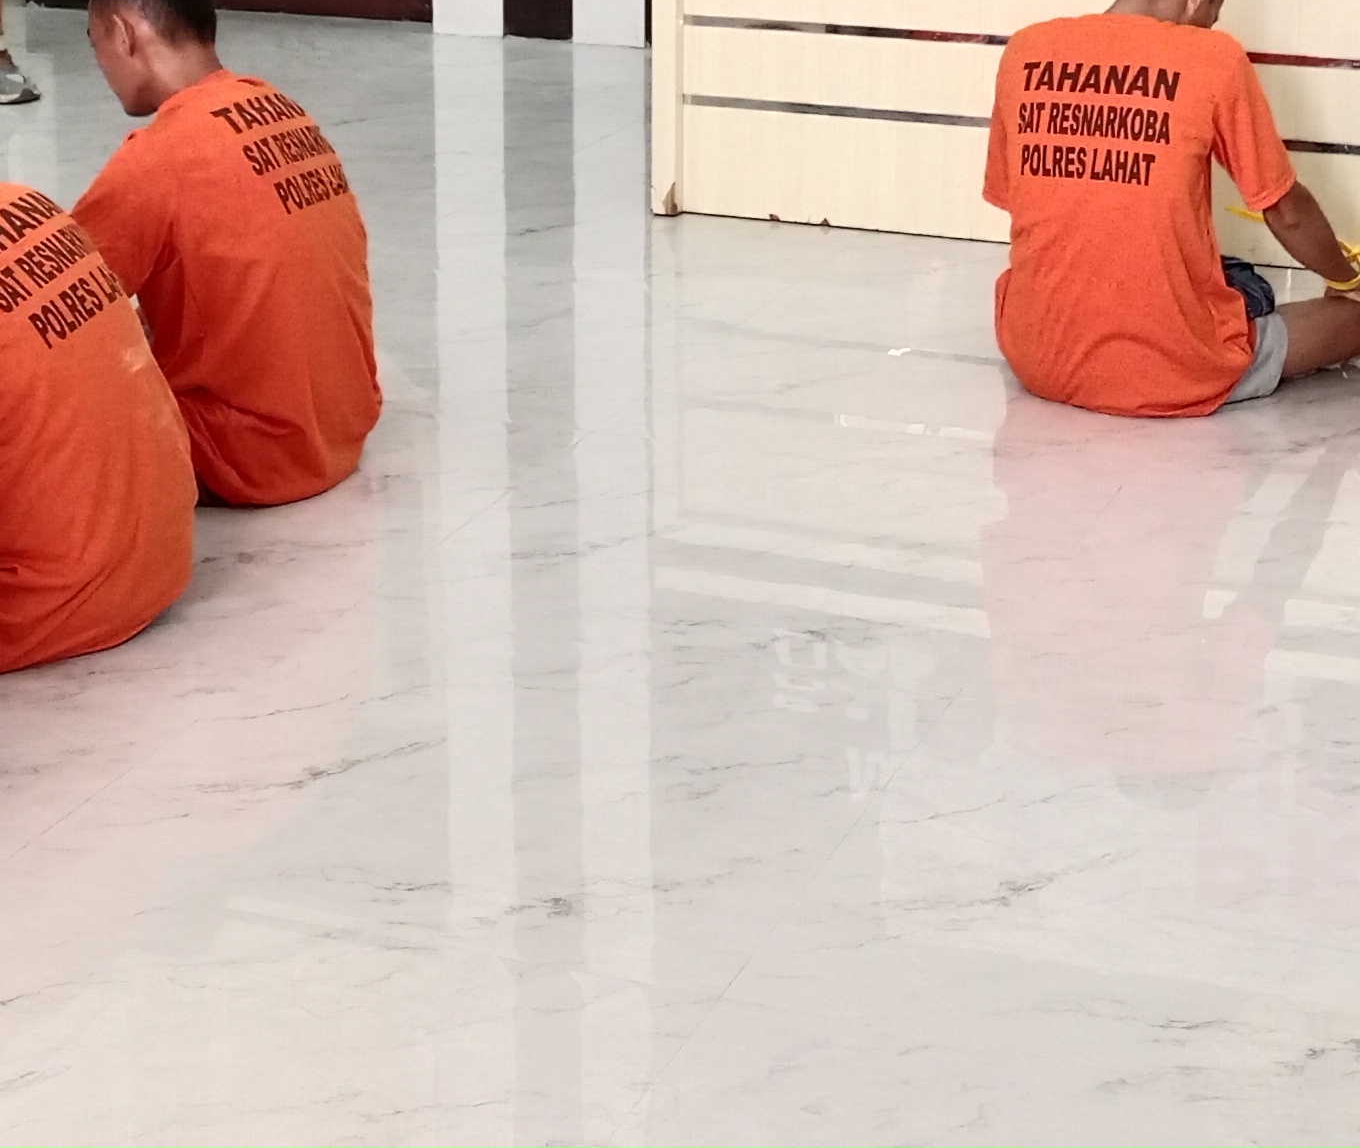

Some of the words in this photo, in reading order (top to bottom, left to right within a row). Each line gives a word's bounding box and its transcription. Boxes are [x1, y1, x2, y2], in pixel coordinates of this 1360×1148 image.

[1024, 61, 1180, 101] TAHANAN
[1018, 102, 1045, 134] SAT
[1047, 102, 1170, 145] RESNARKOBA
[242, 137, 281, 176] SAT
[1021, 144, 1087, 179] POLRES
[1090, 148, 1155, 186] LAHAT
[273, 166, 330, 215] POLRES
[28, 277, 104, 349] POLRES
